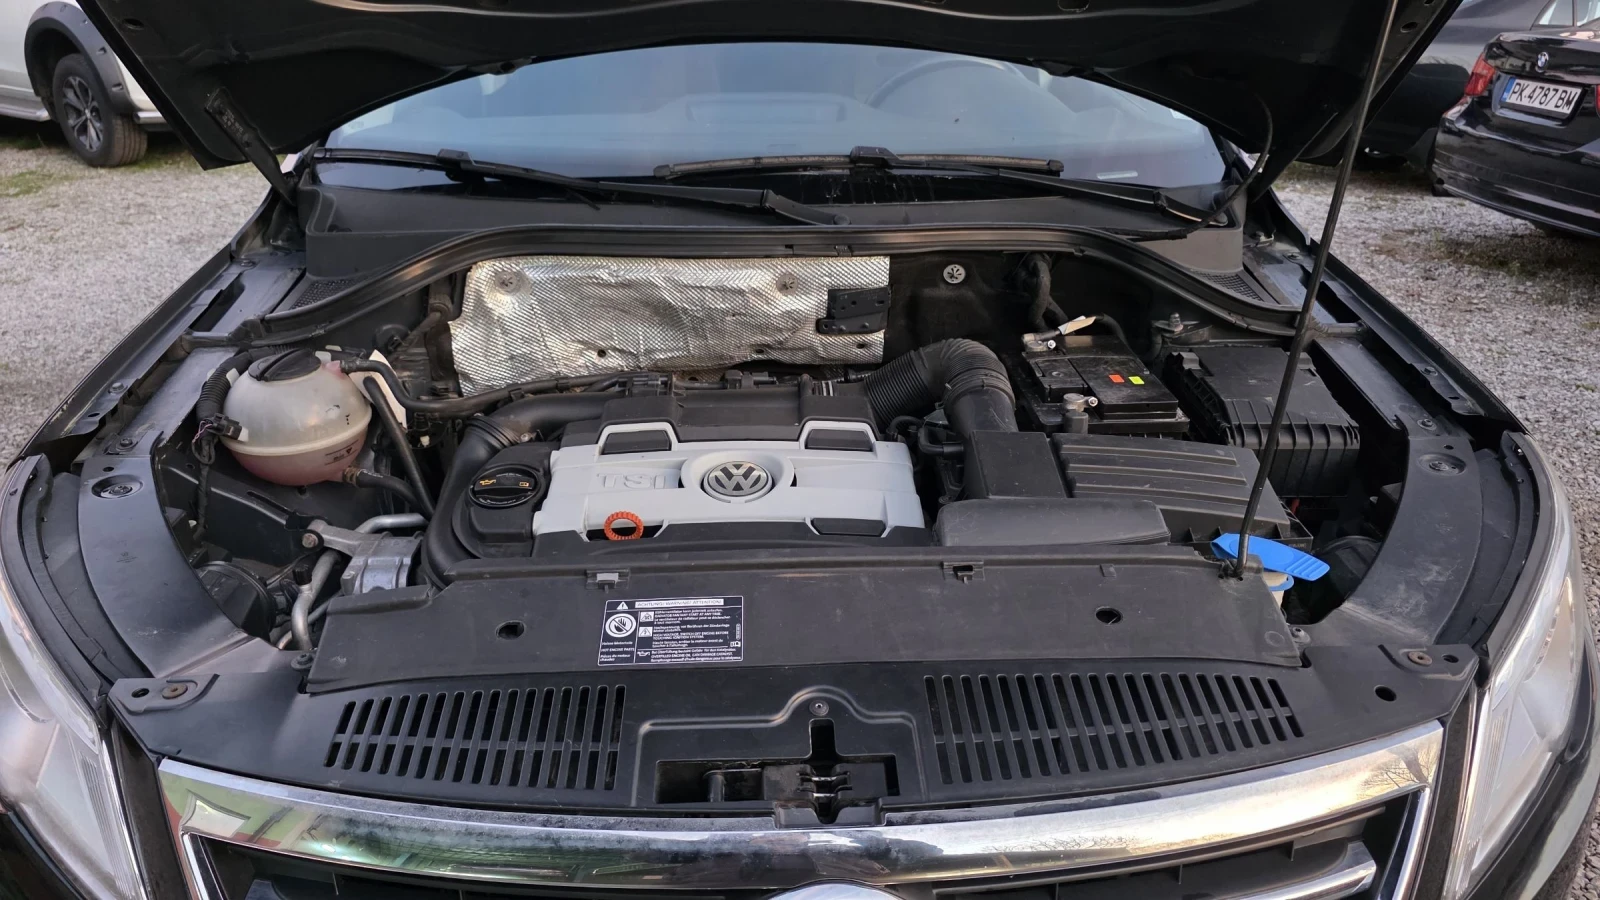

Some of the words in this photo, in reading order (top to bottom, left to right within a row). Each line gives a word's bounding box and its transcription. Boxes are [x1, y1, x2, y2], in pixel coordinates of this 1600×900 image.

[1508, 82, 1530, 102] PK
[1527, 85, 1560, 107] 4787
[1554, 89, 1578, 111] BM
[596, 472, 667, 490] TSI
